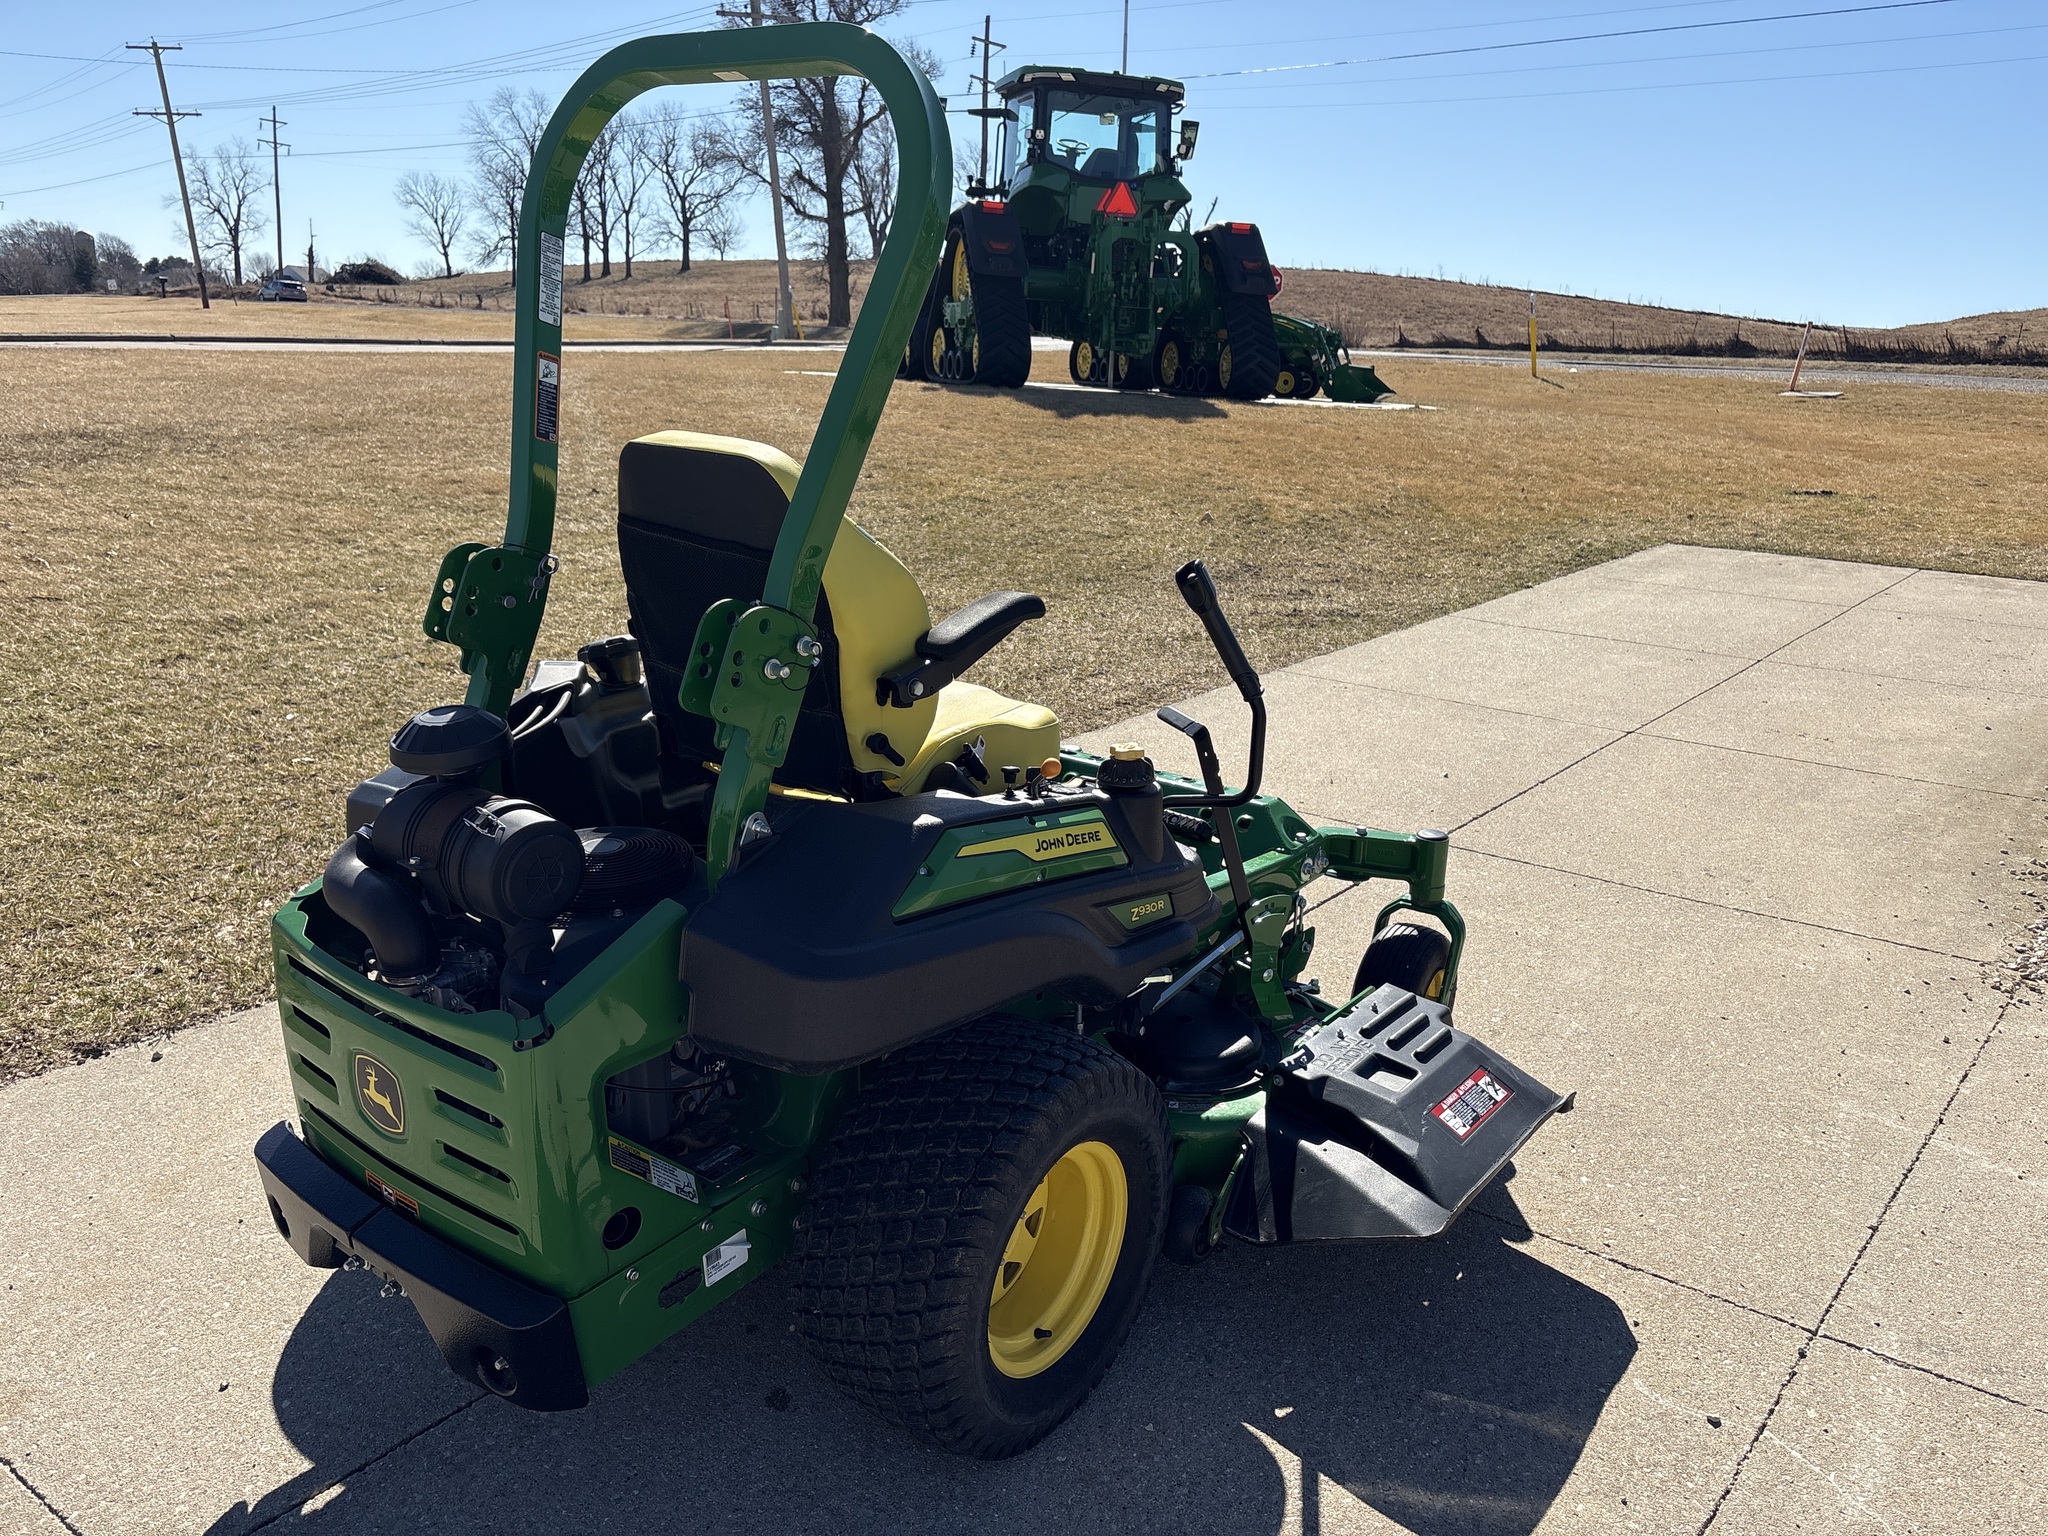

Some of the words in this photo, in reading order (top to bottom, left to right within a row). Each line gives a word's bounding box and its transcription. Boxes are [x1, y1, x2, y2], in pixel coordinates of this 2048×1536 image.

[1035, 836, 1065, 853] JOHN
[1066, 830, 1102, 847] DEERE
[1130, 899, 1165, 922] Z930R
